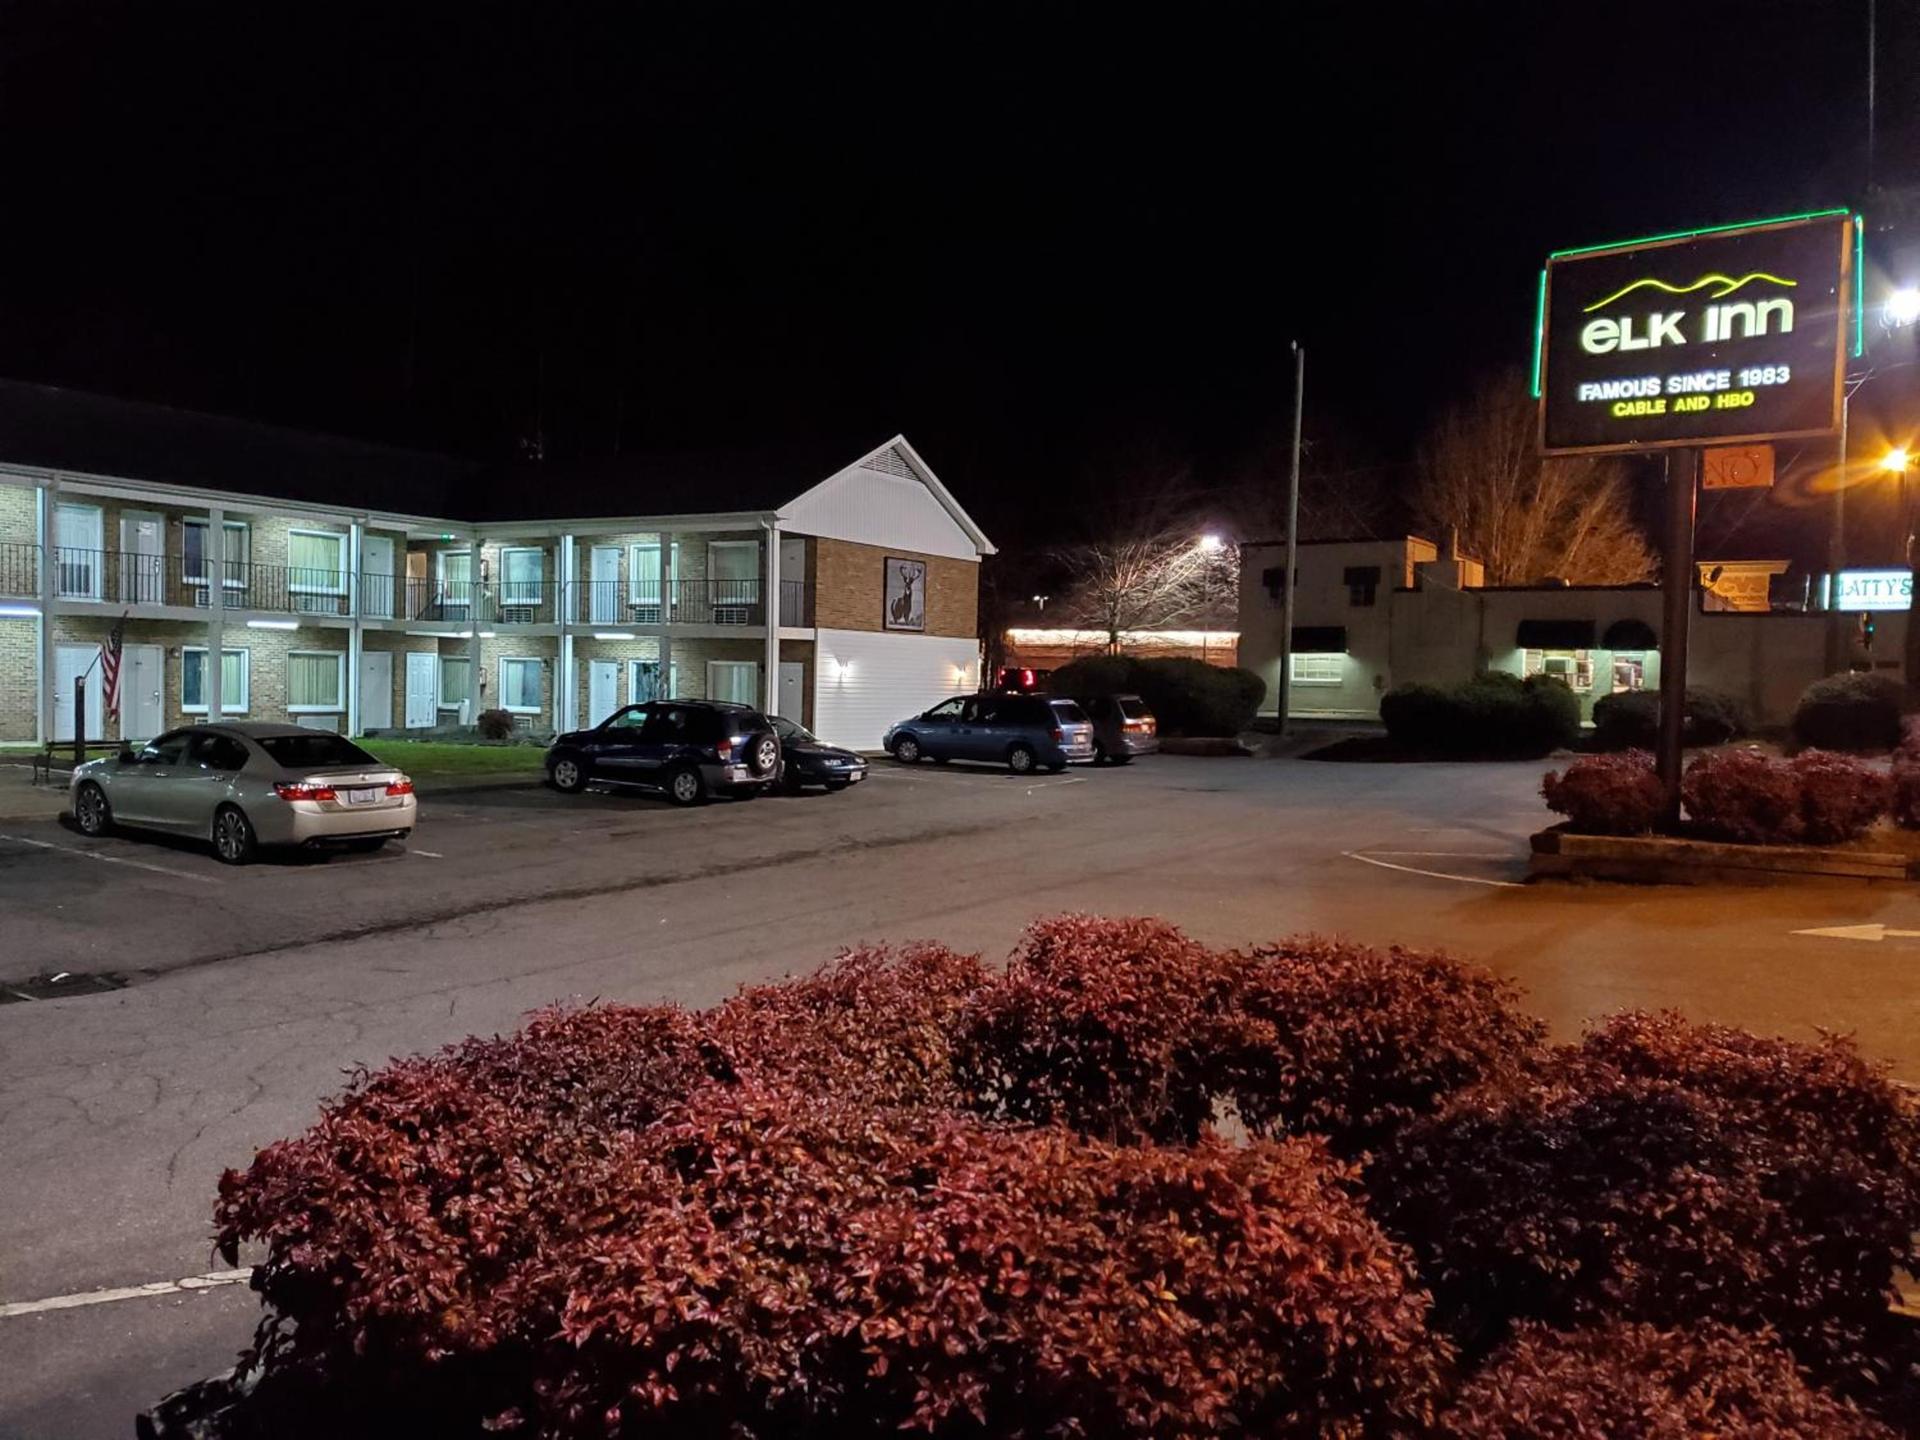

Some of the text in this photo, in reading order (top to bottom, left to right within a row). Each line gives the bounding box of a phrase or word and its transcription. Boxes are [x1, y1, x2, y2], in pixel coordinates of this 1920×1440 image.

[1578, 366, 1791, 402] FAMOUS SINCE 1983
[1612, 391, 1756, 418] CABLE AND HBO
